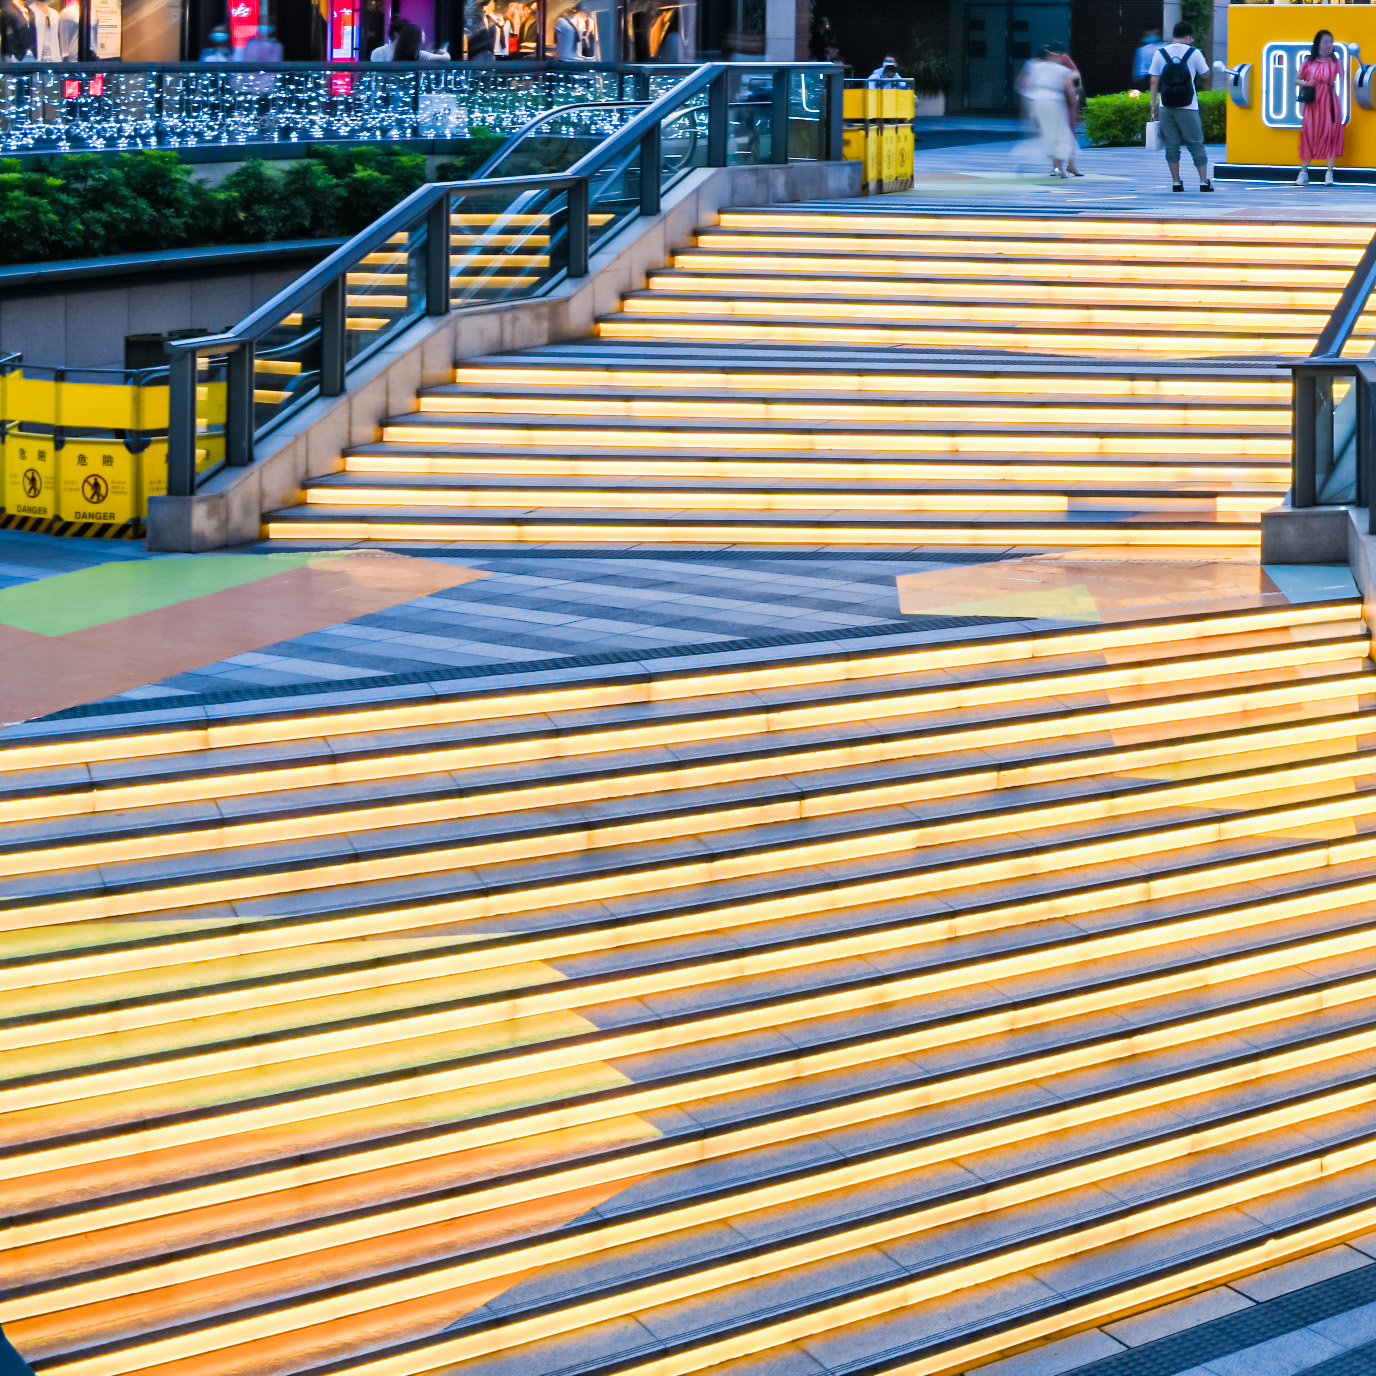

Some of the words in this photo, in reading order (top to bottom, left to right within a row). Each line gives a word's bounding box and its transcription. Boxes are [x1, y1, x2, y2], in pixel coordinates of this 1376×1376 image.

[77, 453, 114, 467] 危險
[17, 505, 47, 515] DANGER
[75, 511, 115, 520] DANGER
